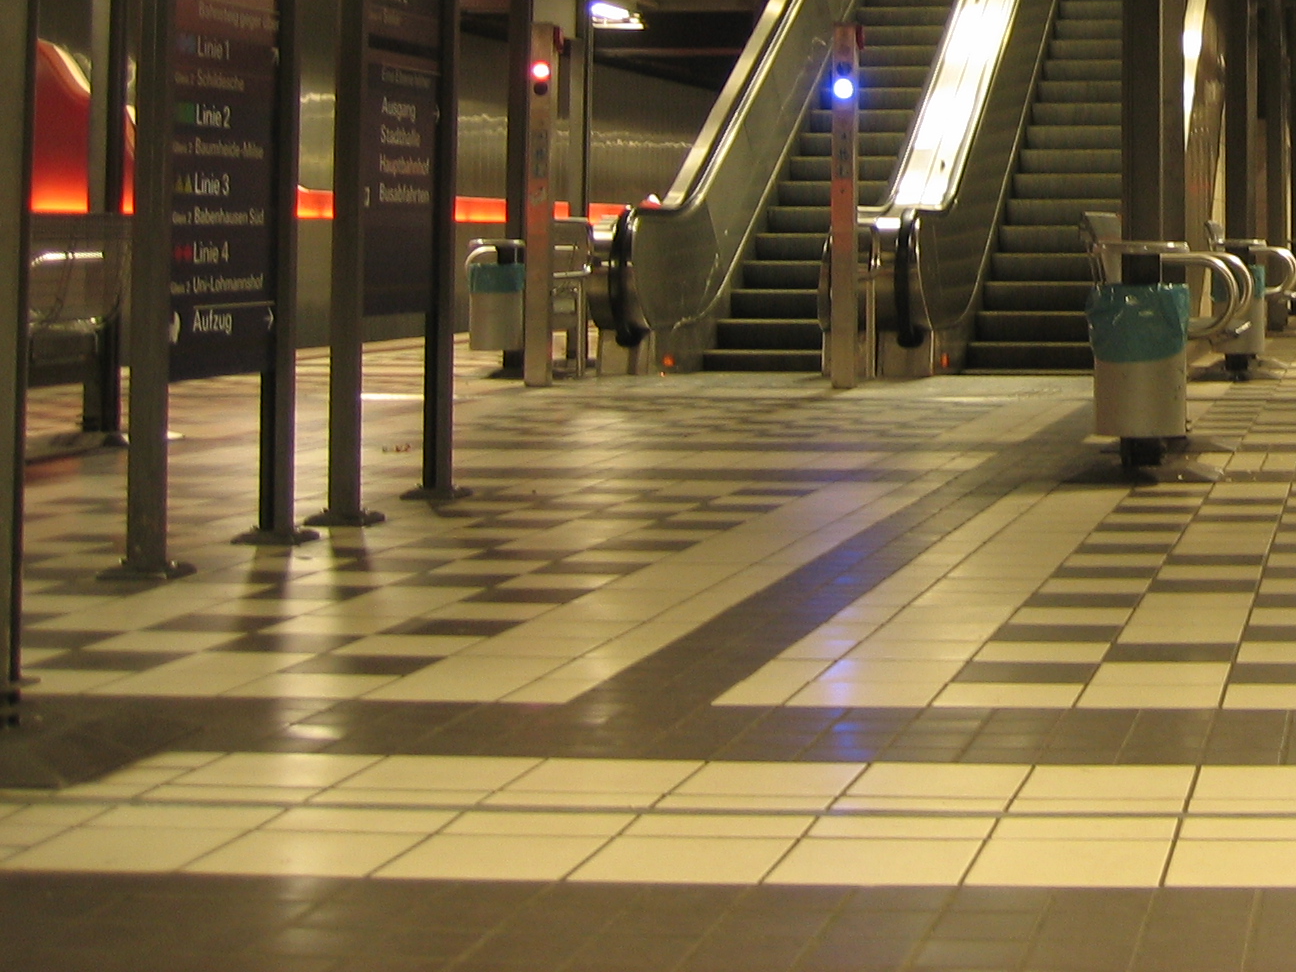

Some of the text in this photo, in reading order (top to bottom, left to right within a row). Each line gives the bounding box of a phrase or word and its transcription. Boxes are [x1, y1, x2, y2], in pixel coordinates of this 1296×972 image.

[197, 34, 231, 61] Linie 1
[196, 102, 232, 129] Linie 2
[381, 96, 417, 124] Ausgang
[379, 153, 431, 178] Hauptbahnhof
[194, 171, 230, 196] Linie 3
[193, 240, 230, 264] Linie 4
[192, 308, 233, 336] Aufzug
